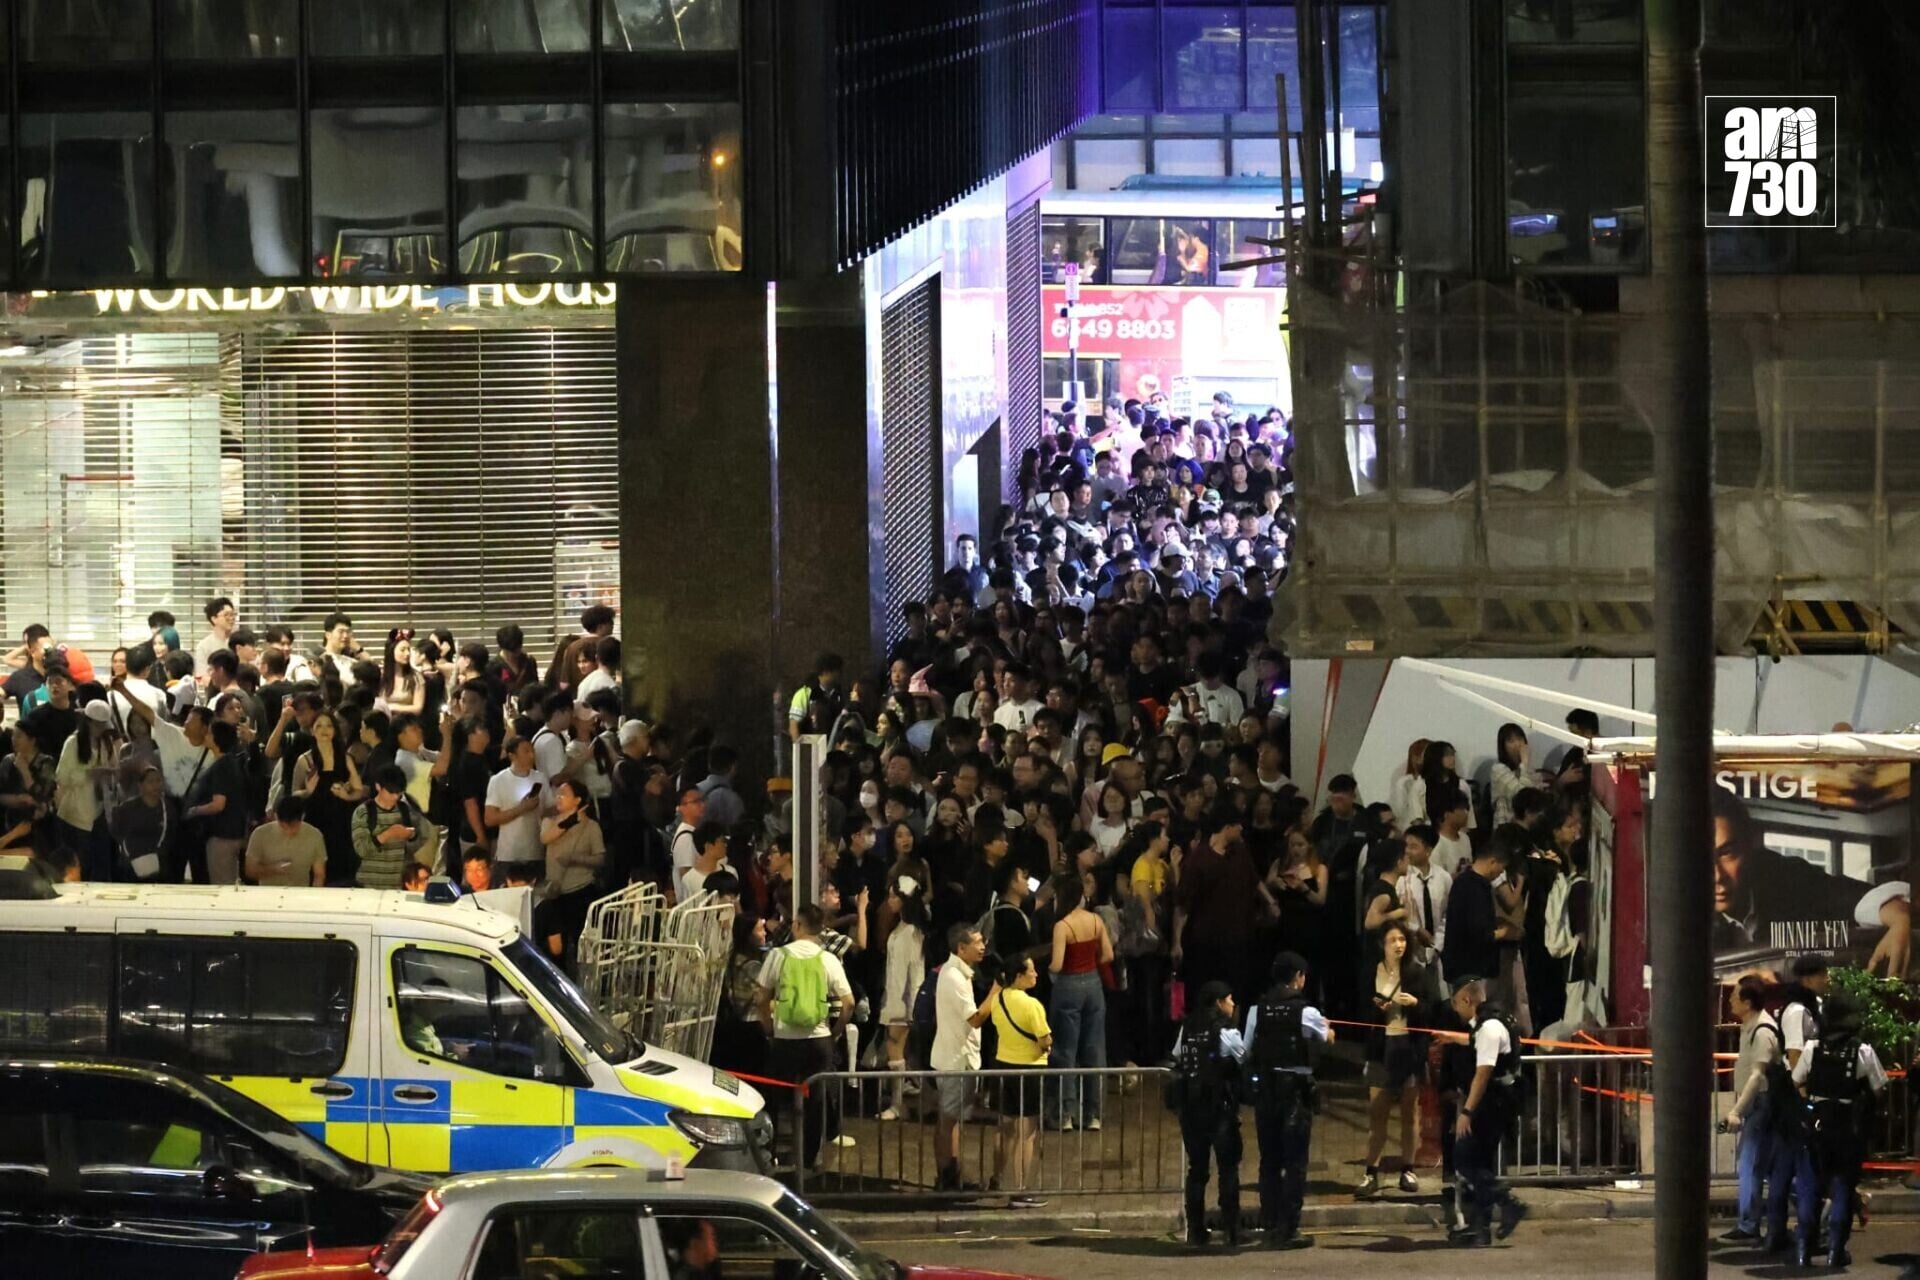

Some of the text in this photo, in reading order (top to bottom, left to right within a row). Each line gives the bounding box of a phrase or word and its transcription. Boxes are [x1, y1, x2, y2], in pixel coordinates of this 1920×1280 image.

[1051, 318, 1176, 339] 649 8803
[1824, 920, 1849, 949] YEN
